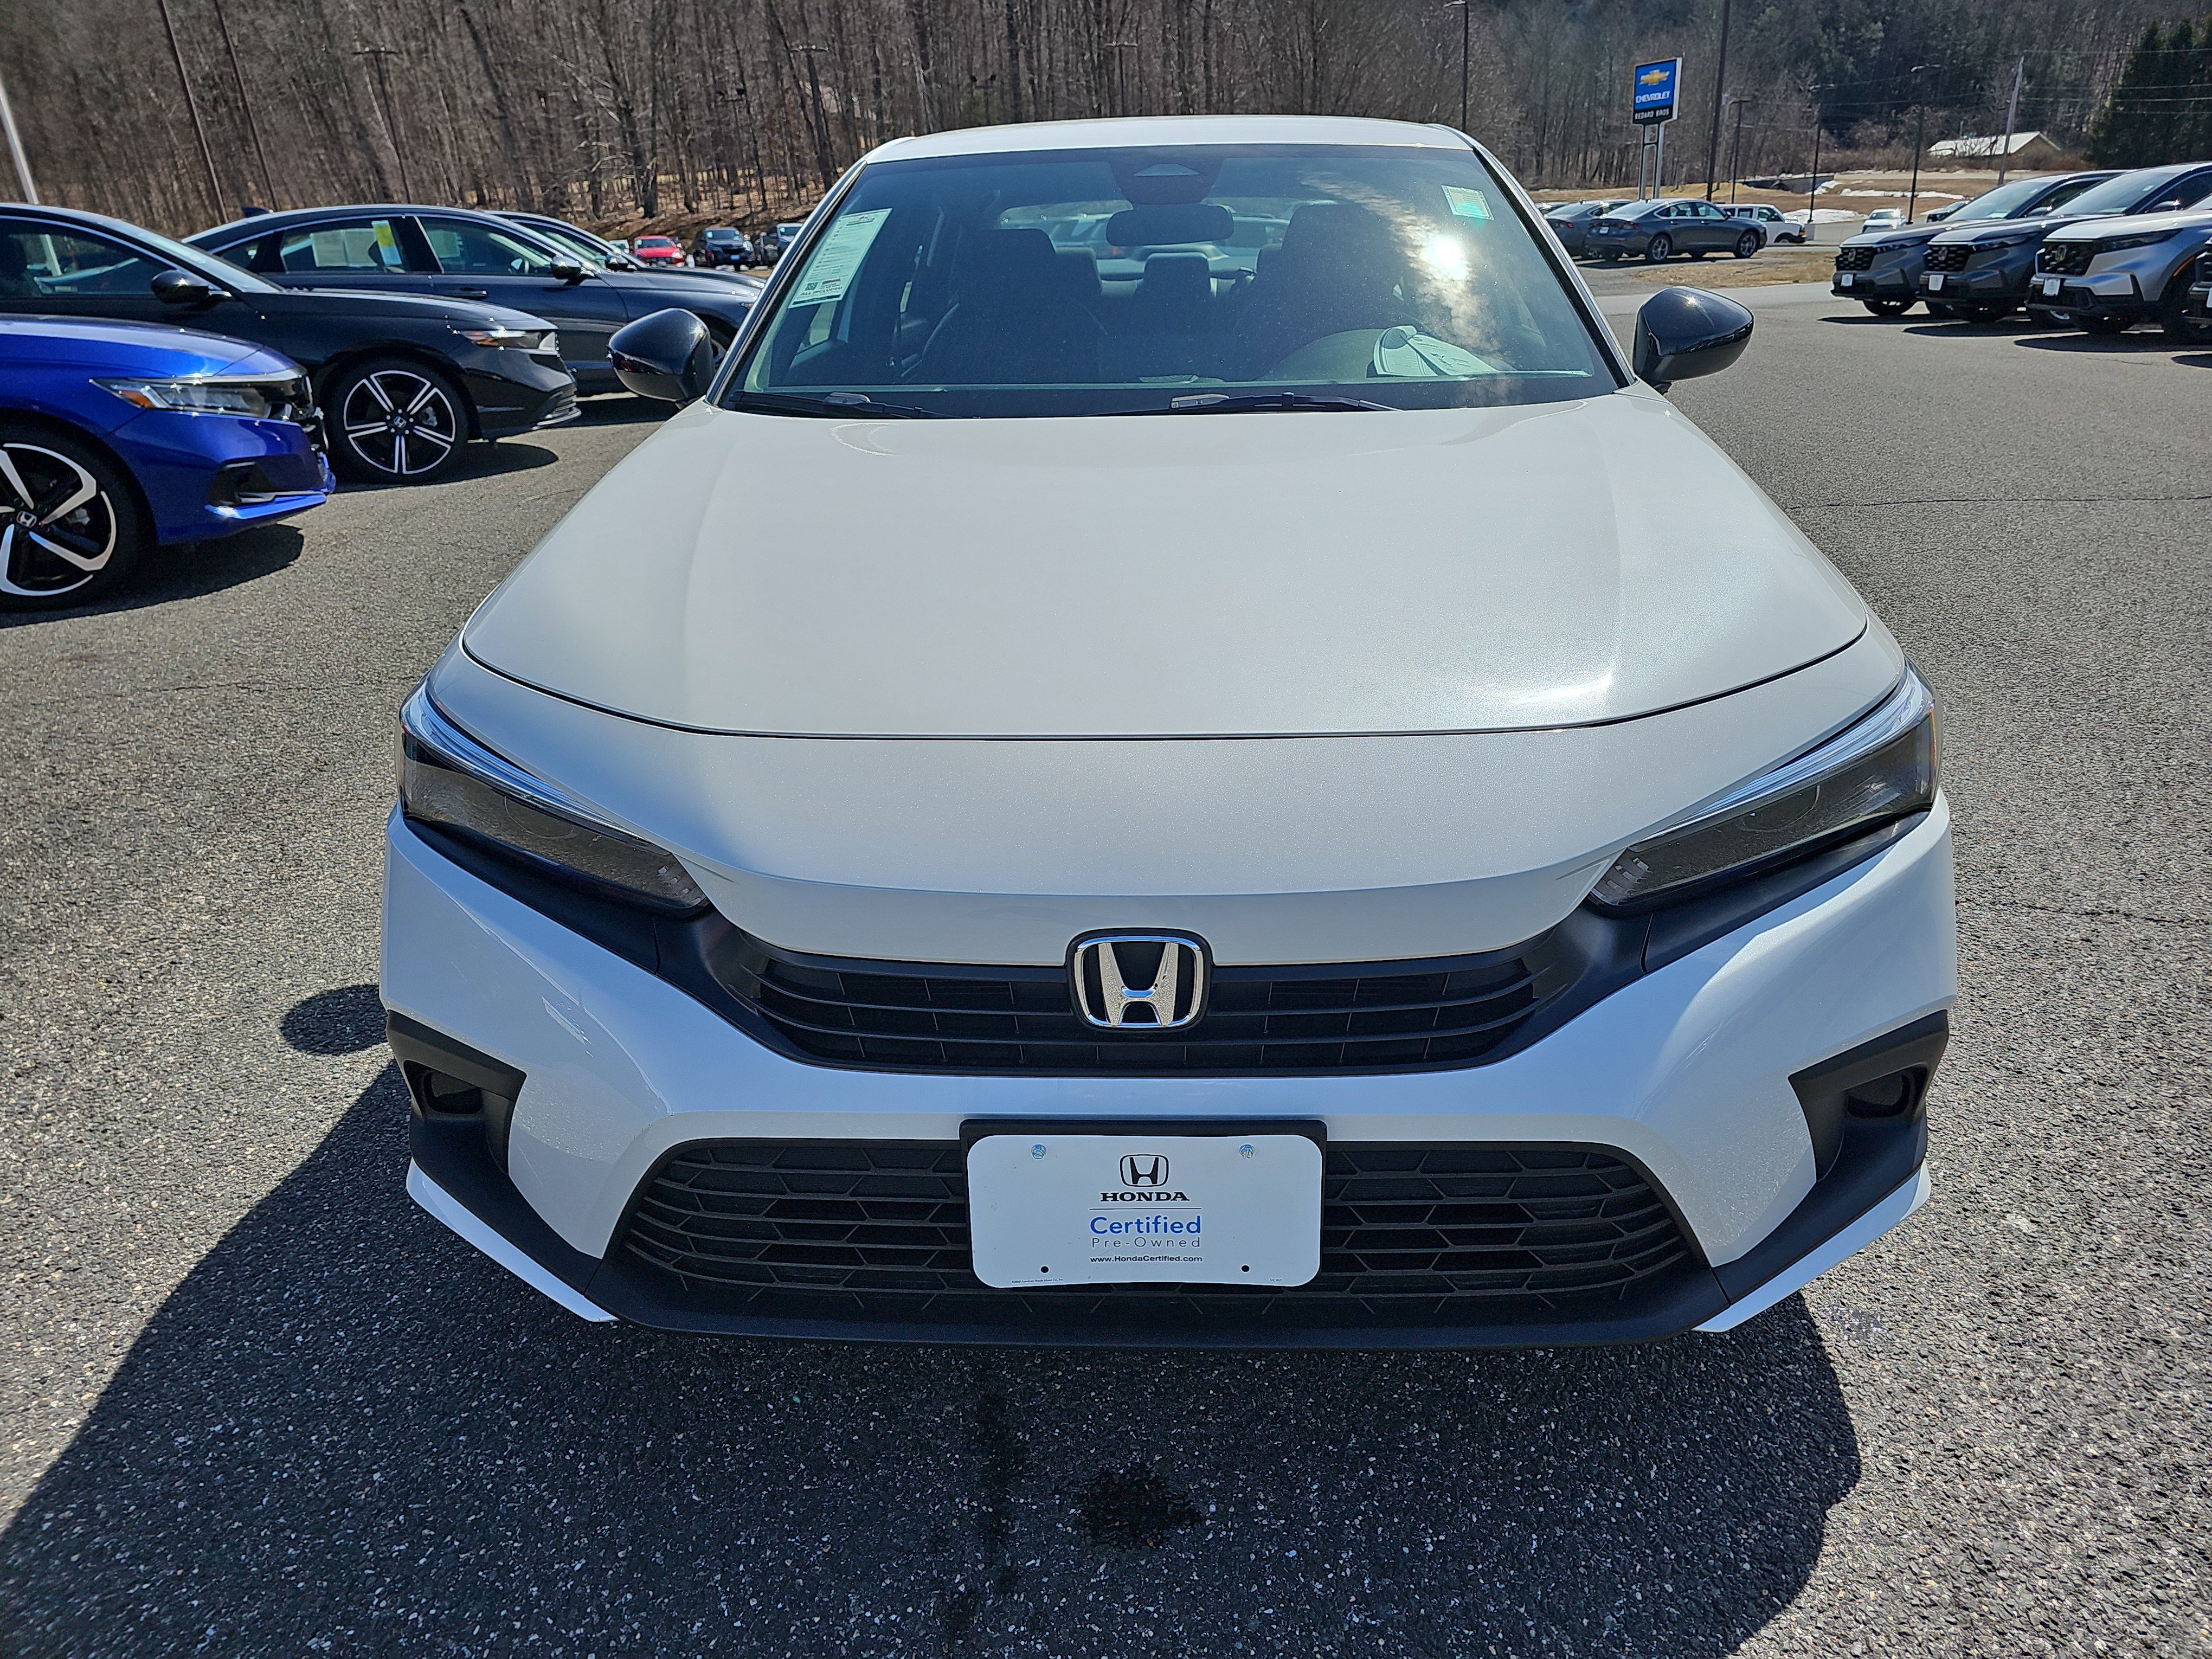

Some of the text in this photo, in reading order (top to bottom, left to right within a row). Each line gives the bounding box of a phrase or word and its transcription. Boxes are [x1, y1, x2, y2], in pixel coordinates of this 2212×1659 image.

[1635, 91, 1670, 103] CHEVROLET
[1100, 1192, 1190, 1201] HONDA
[1090, 1215, 1201, 1234] Certified
[1092, 1237, 1200, 1248] Pre-Owned
